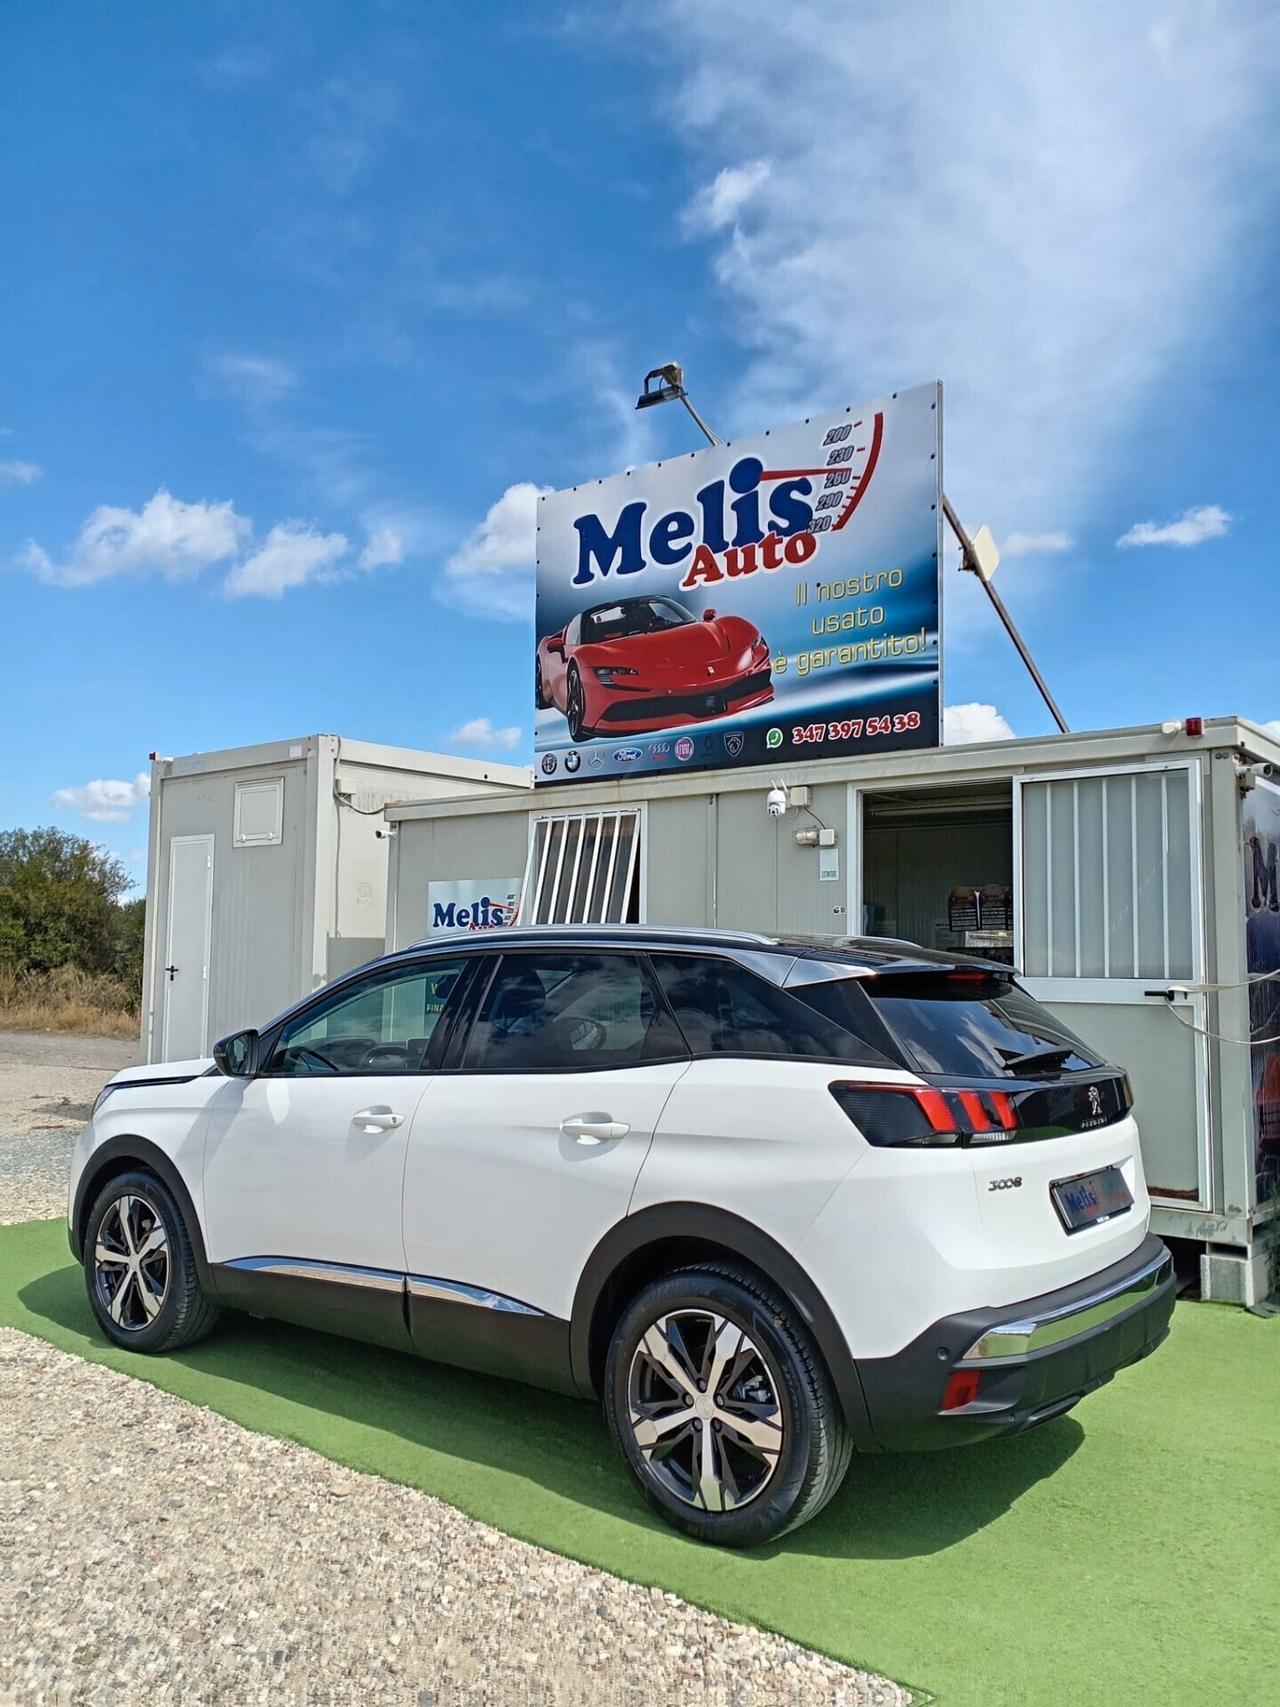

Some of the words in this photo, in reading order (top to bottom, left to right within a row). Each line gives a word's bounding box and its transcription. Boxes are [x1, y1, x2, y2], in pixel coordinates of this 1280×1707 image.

[823, 424, 852, 446] 200
[826, 445, 854, 466] 230
[824, 468, 851, 489] 260
[815, 491, 843, 511] 290
[572, 456, 814, 584] Melis
[807, 515, 832, 534] 320
[682, 531, 817, 587] Auto
[795, 581, 807, 606] Il
[816, 568, 904, 601] nostro
[812, 606, 885, 635] usato
[774, 651, 787, 674] è
[797, 626, 928, 676] garantito!
[792, 724, 826, 744] 347
[828, 719, 863, 740] 397
[866, 715, 891, 736] 54
[893, 711, 920, 732] 38
[432, 896, 504, 928] Melis
[988, 1176, 1022, 1191] 3008
